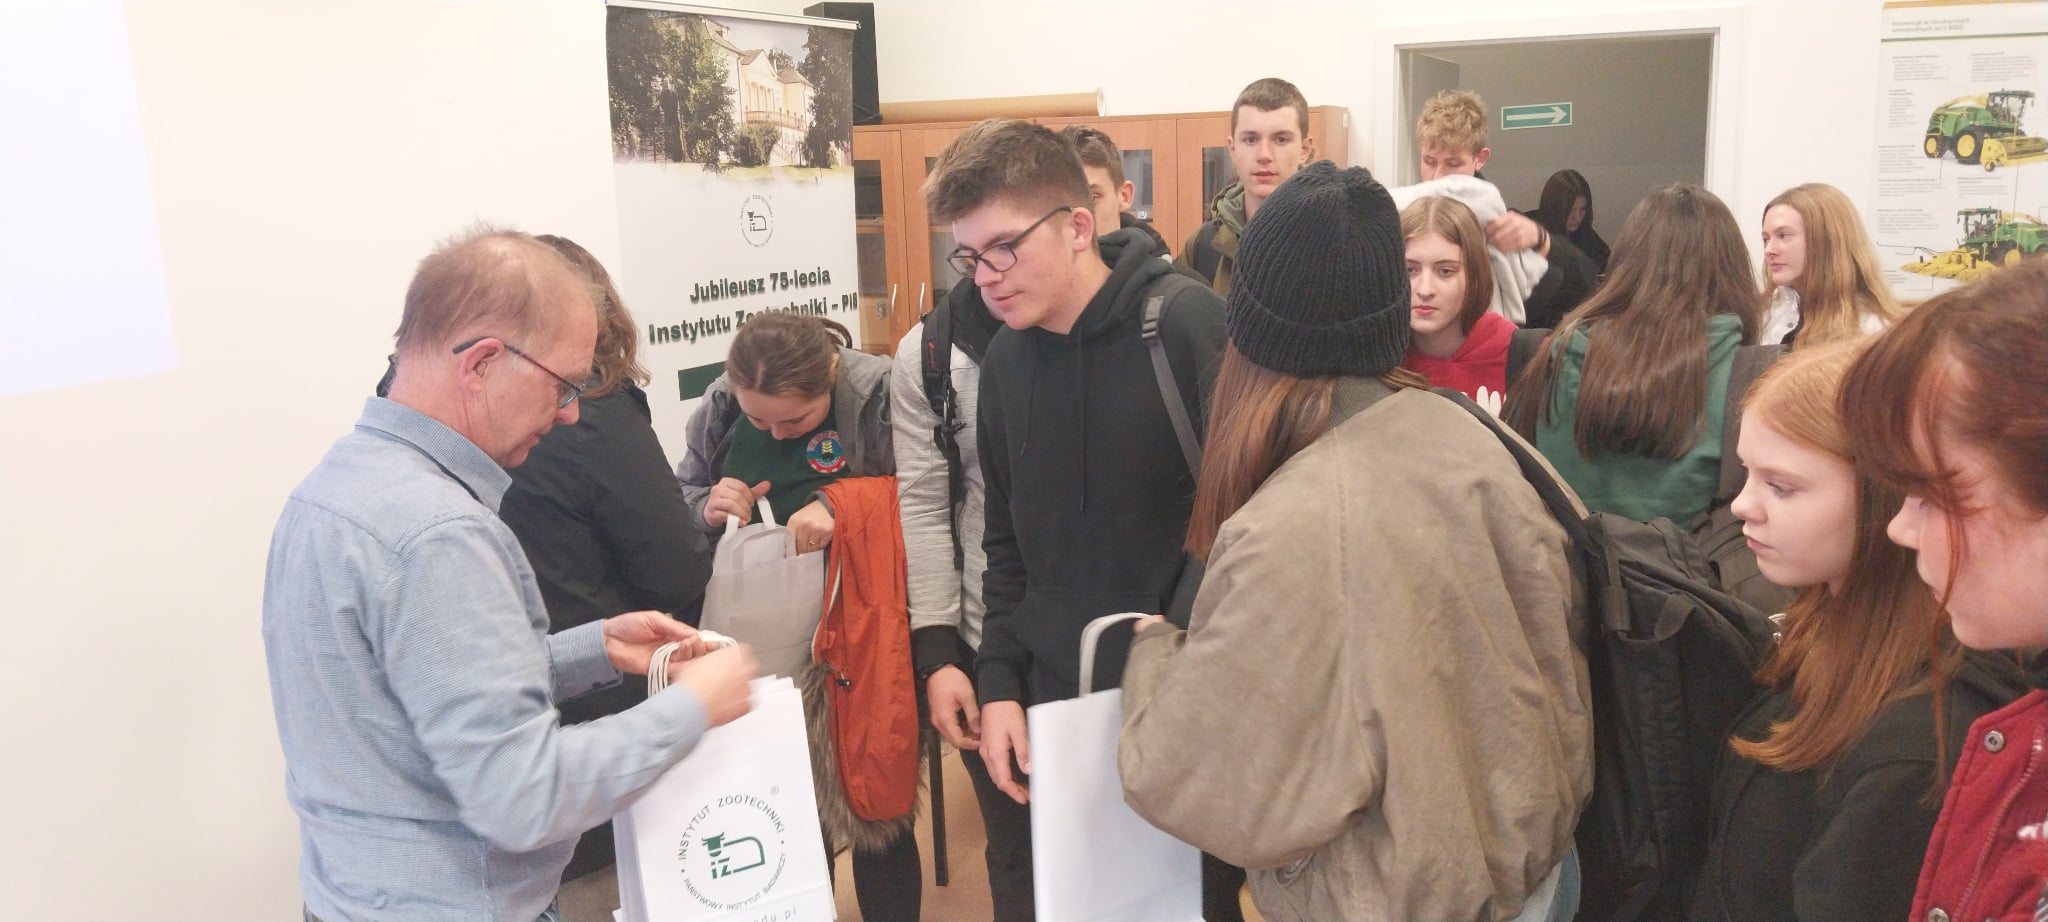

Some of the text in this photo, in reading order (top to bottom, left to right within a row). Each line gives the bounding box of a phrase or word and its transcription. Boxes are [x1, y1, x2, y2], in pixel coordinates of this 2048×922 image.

[690, 267, 831, 304] Jubileusz 75-lecia
[648, 314, 731, 344] Instytutu
[678, 794, 785, 860] INSTYTUT ZOOTECHNIKI
[726, 893, 761, 911] INSTYTUT
